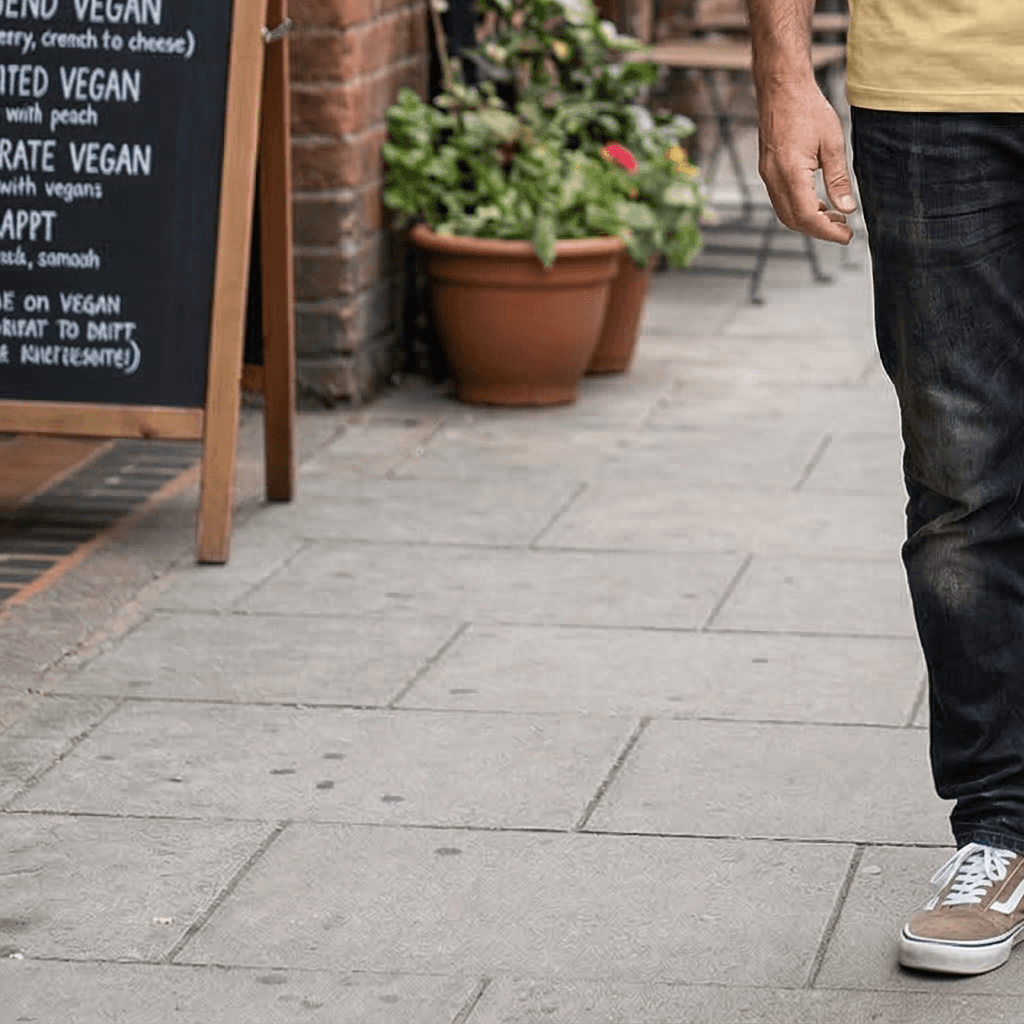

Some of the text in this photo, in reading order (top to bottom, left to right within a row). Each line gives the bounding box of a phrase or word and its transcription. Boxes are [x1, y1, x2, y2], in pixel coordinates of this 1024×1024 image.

[101, 29, 124, 51] to
[59, 66, 141, 103] VEGAN
[49, 103, 98, 132] peach
[69, 142, 152, 176] VEGAN
[0, 174, 37, 196] with
[60, 293, 121, 316] VEGAN
